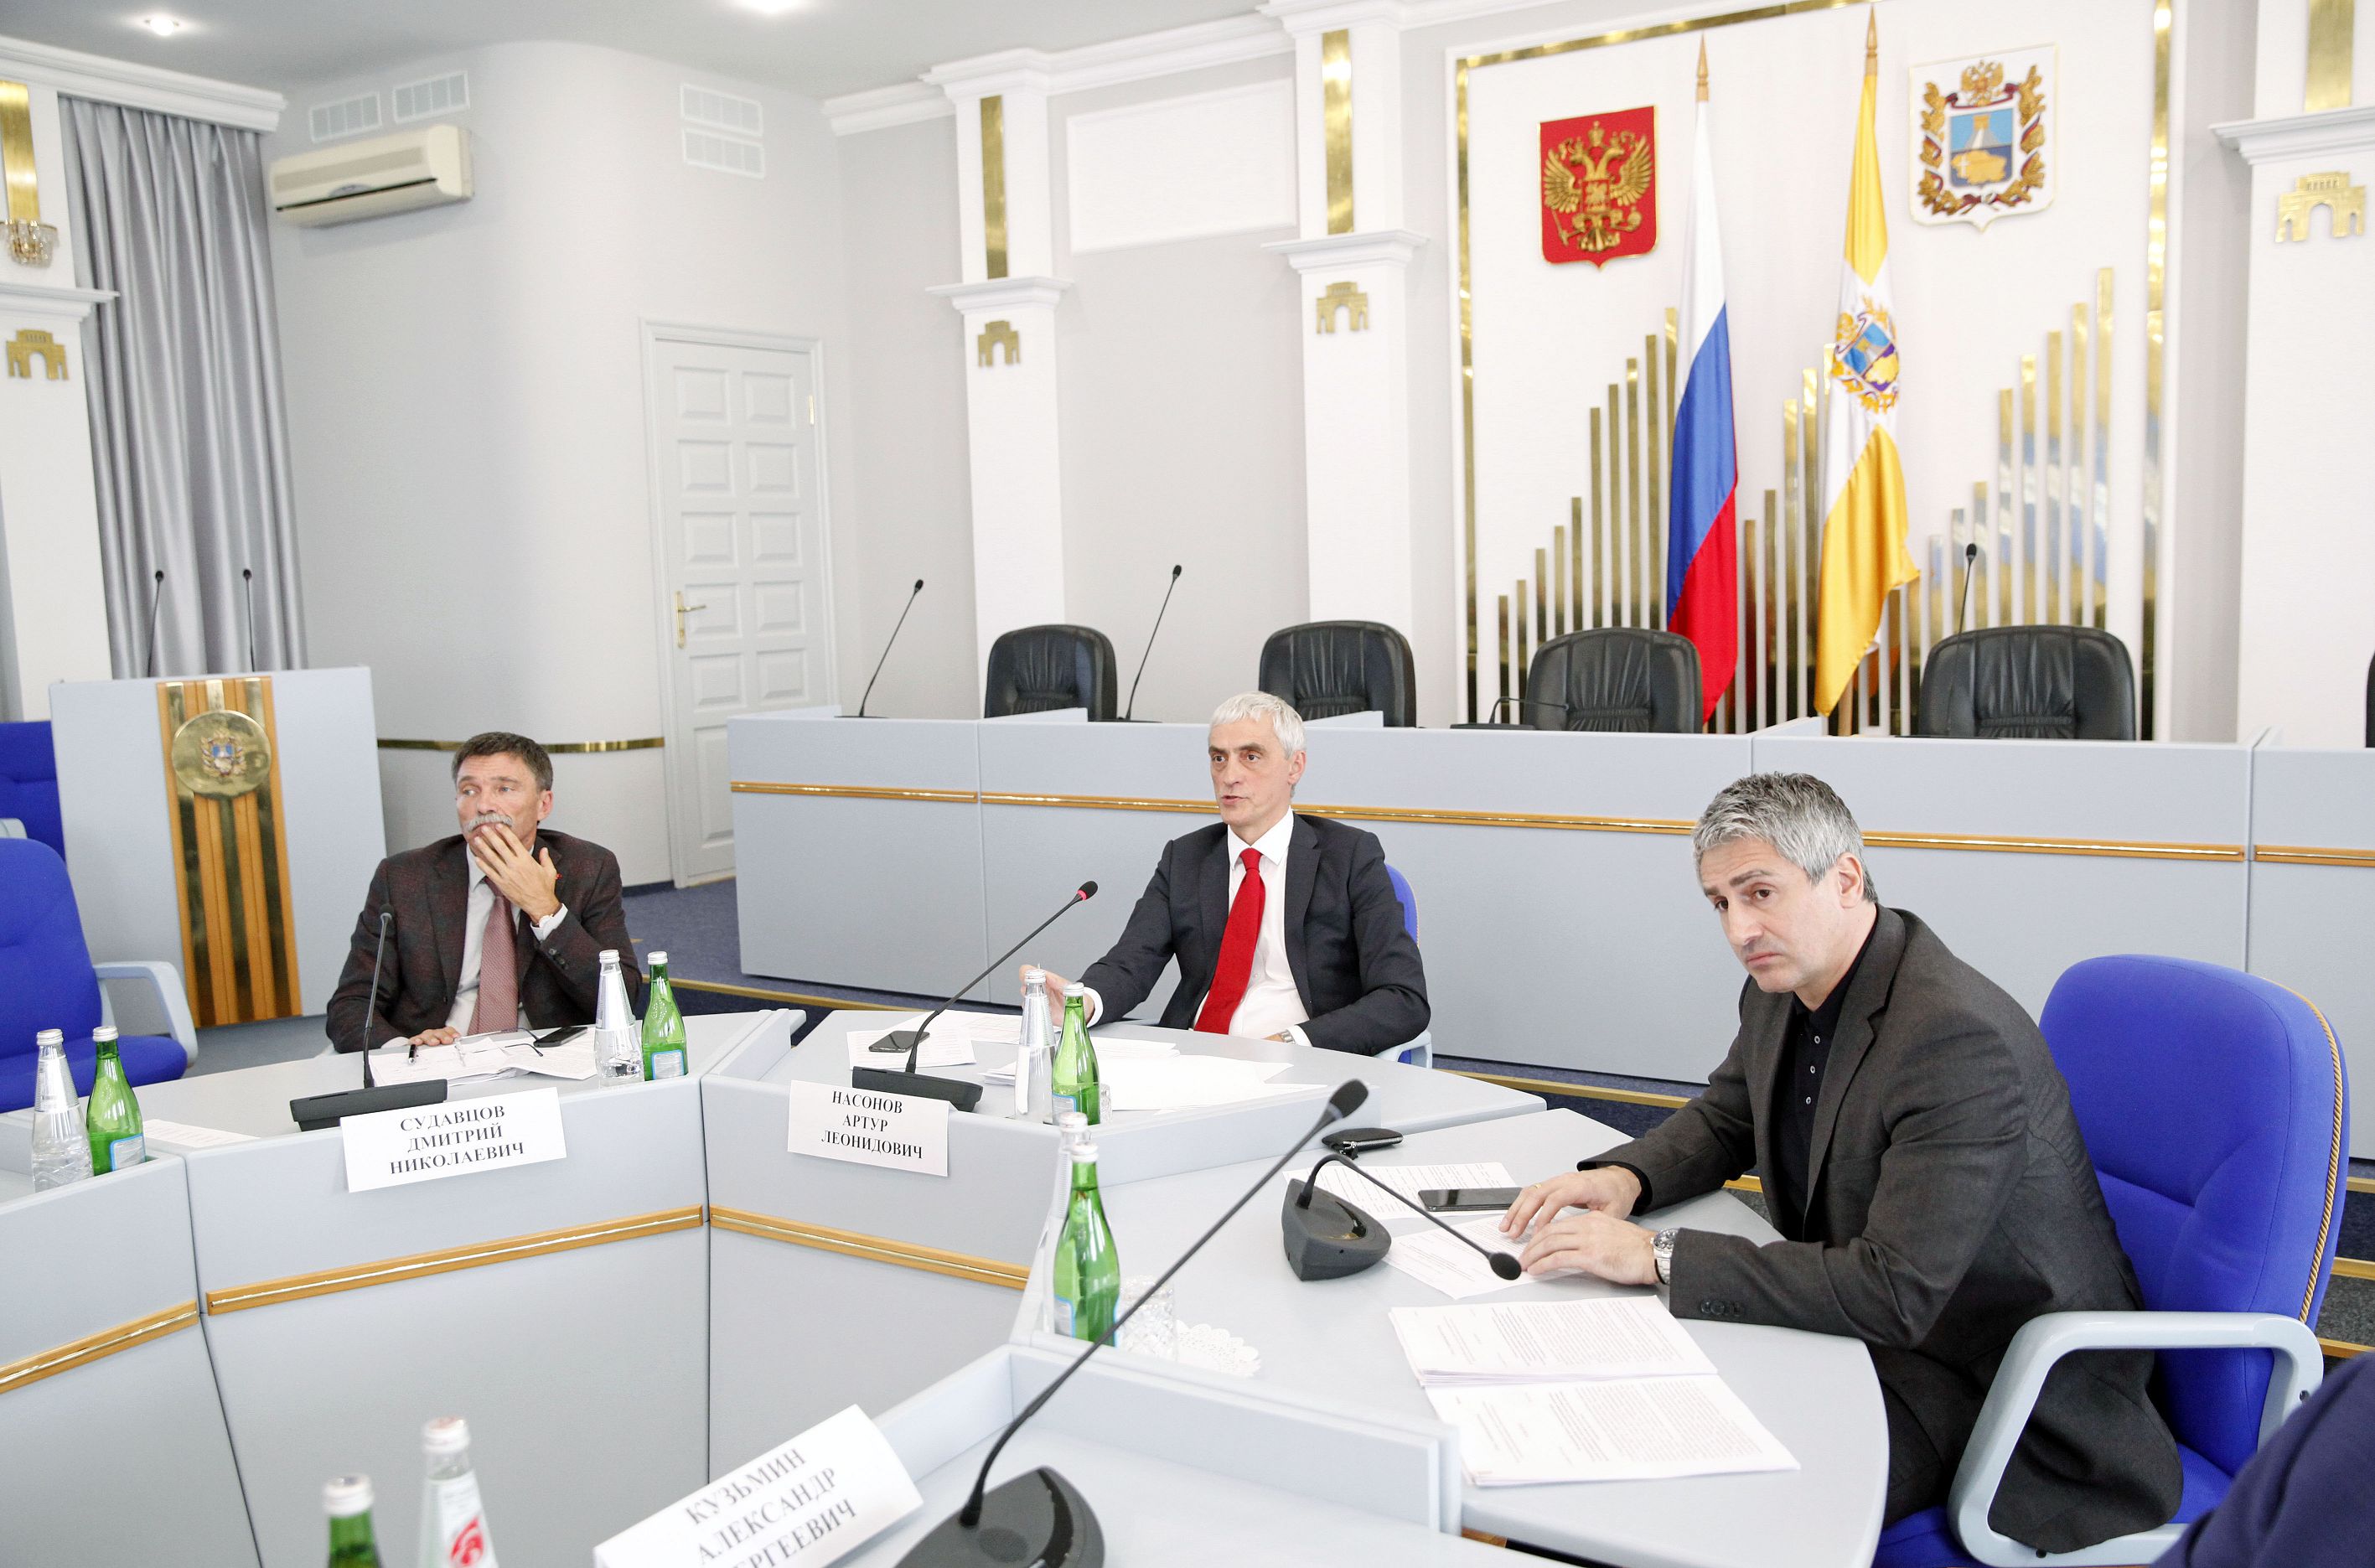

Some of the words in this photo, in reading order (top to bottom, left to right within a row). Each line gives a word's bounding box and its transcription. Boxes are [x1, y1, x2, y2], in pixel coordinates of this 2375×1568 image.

[831, 1090, 903, 1114] НАСОНОВ
[400, 1105, 505, 1131] СУДАВЦОВ
[842, 1114, 888, 1132] АРТУР
[407, 1123, 504, 1153] ДМИТРИЙ
[820, 1130, 923, 1159] ЛЕОНИДОВИЧ
[390, 1141, 525, 1174] НИКОЛАЕВИЧ
[685, 1447, 807, 1525] КУЗЬМИН
[696, 1467, 836, 1565] АЛЕКСАНДР
